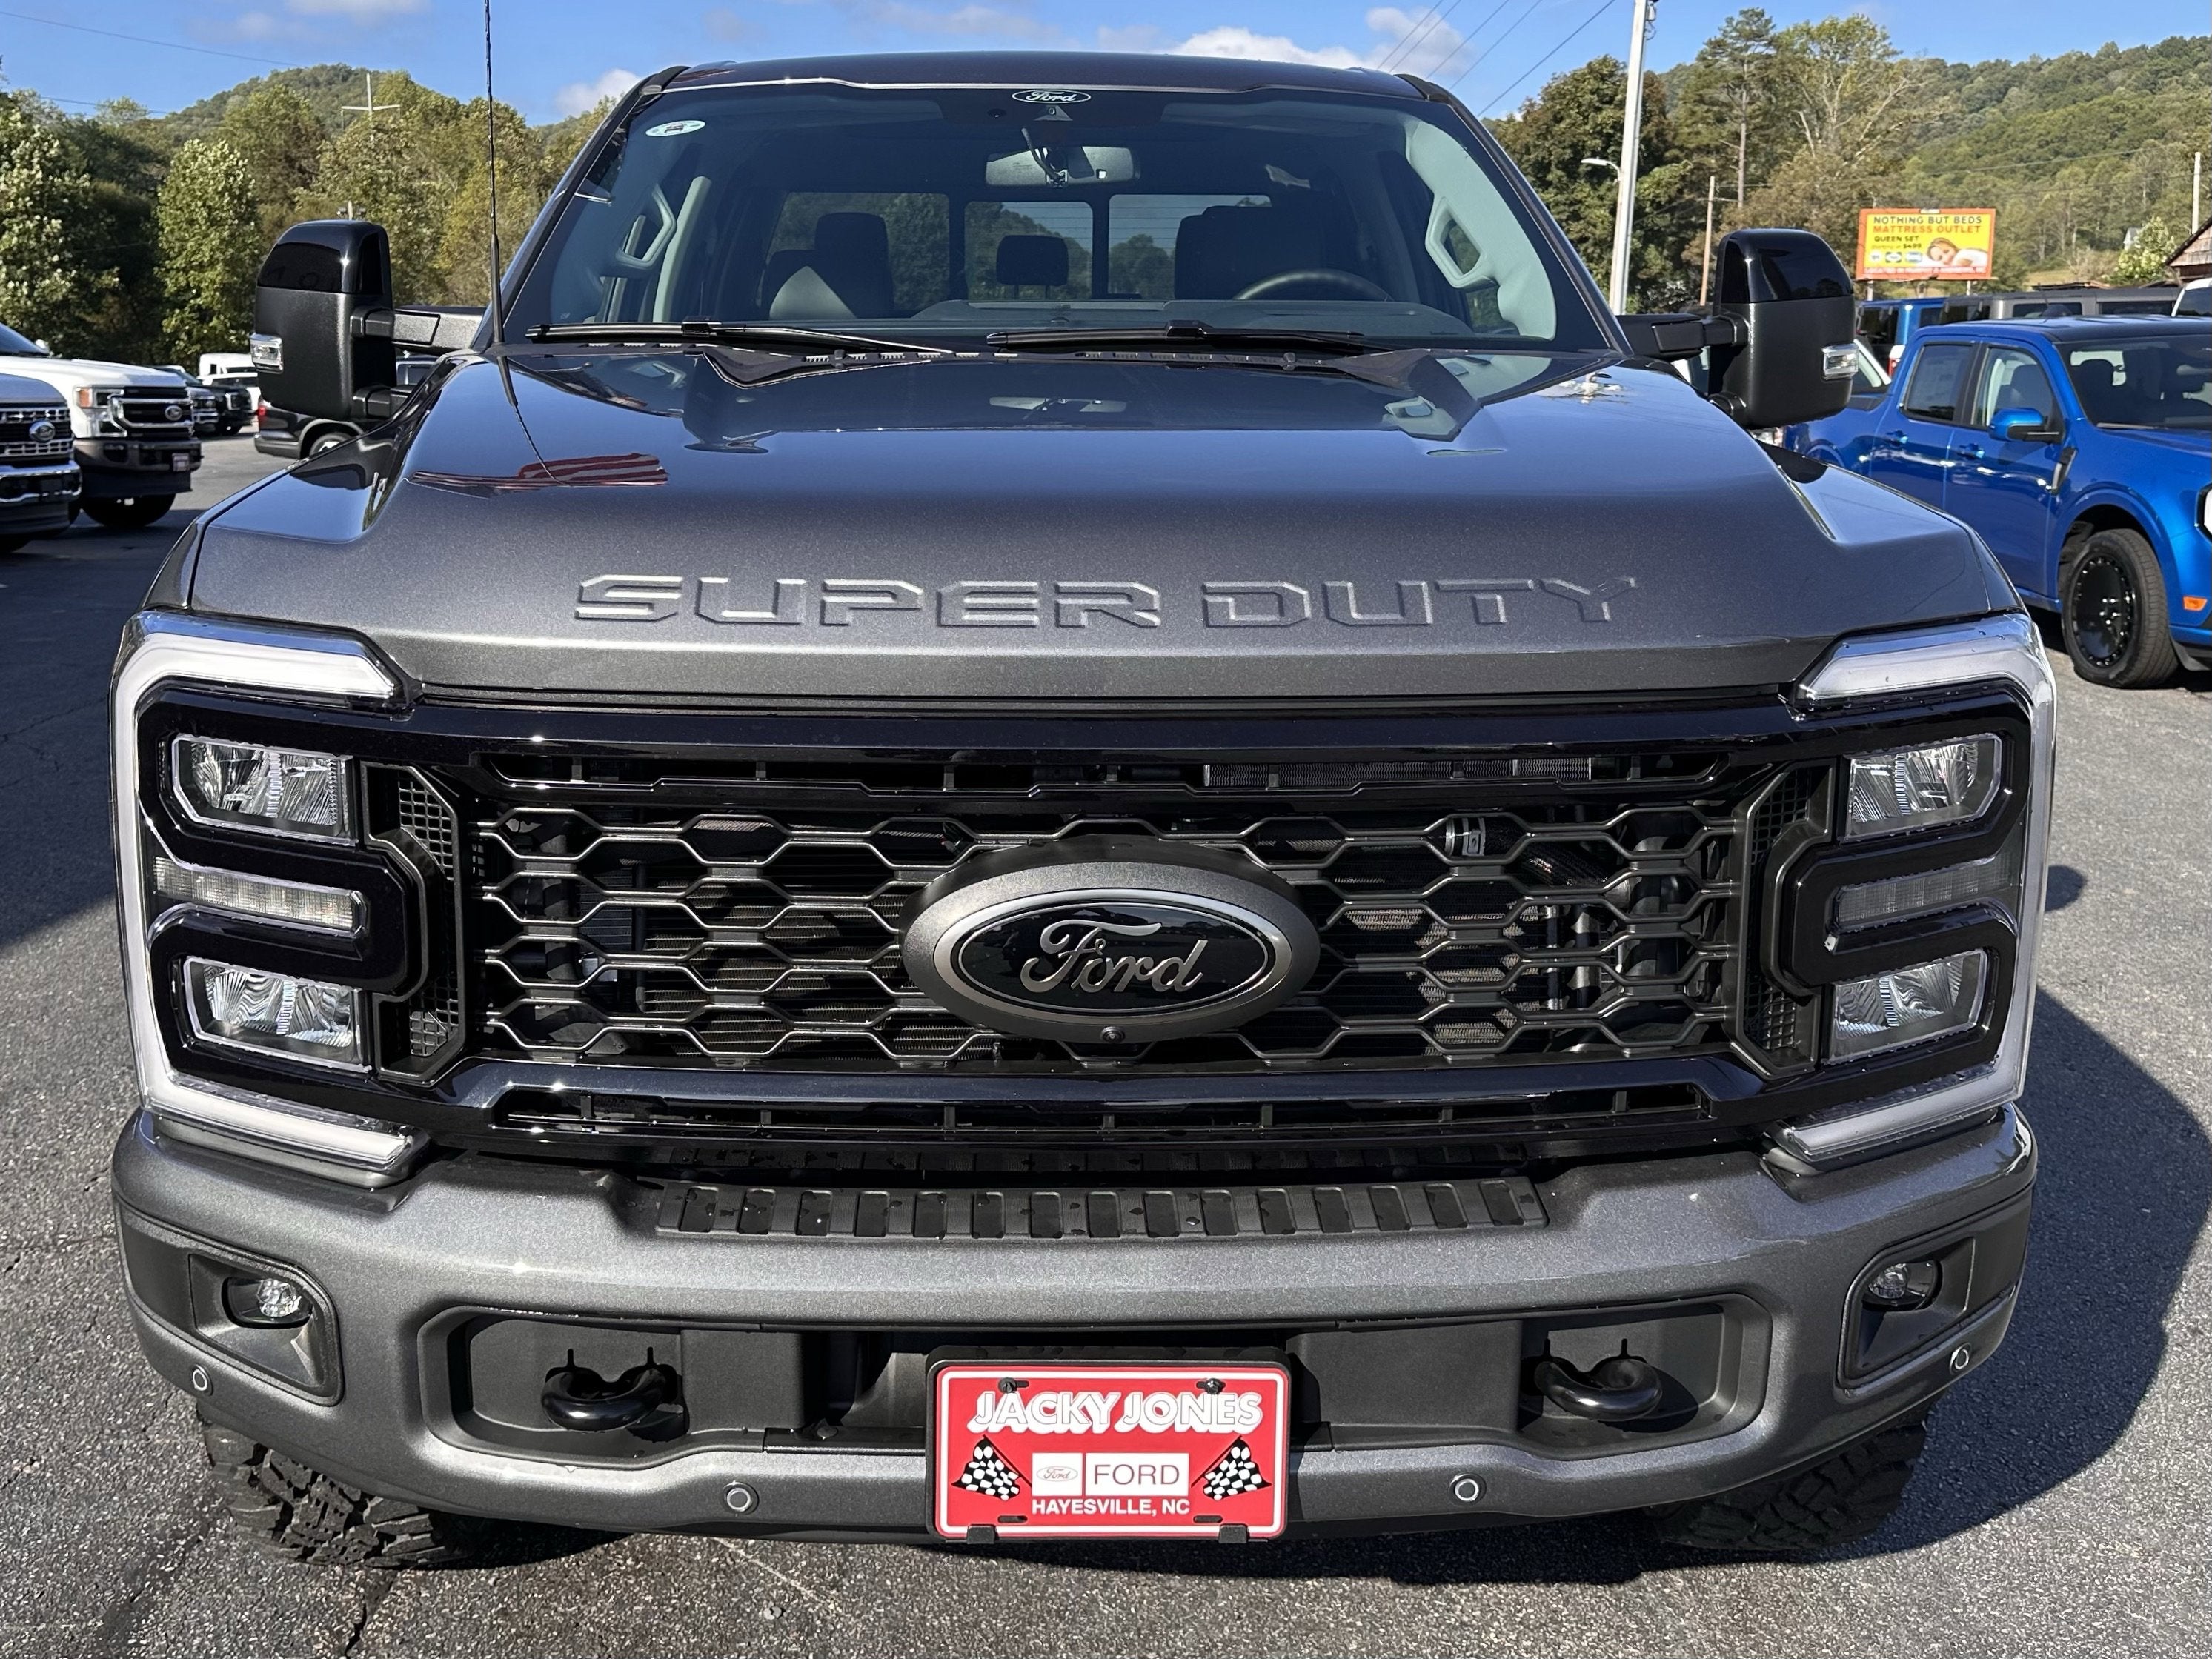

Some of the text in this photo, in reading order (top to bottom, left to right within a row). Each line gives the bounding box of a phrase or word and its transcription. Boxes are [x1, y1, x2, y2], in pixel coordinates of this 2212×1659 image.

[1026, 90, 1077, 102] Ford
[1873, 216, 1924, 225] NOTHING
[1953, 216, 1982, 224] BEDS
[1873, 225, 1981, 233] MATTRESS OUTLET
[574, 574, 1636, 628] SUPER DUTY
[1020, 919, 1209, 993] Ford
[967, 1391, 1263, 1434] JACKY JONES
[1043, 1467, 1071, 1481] Ford
[1094, 1463, 1180, 1486] FORD
[1032, 1499, 1190, 1517] HAYESVILLE, NC
